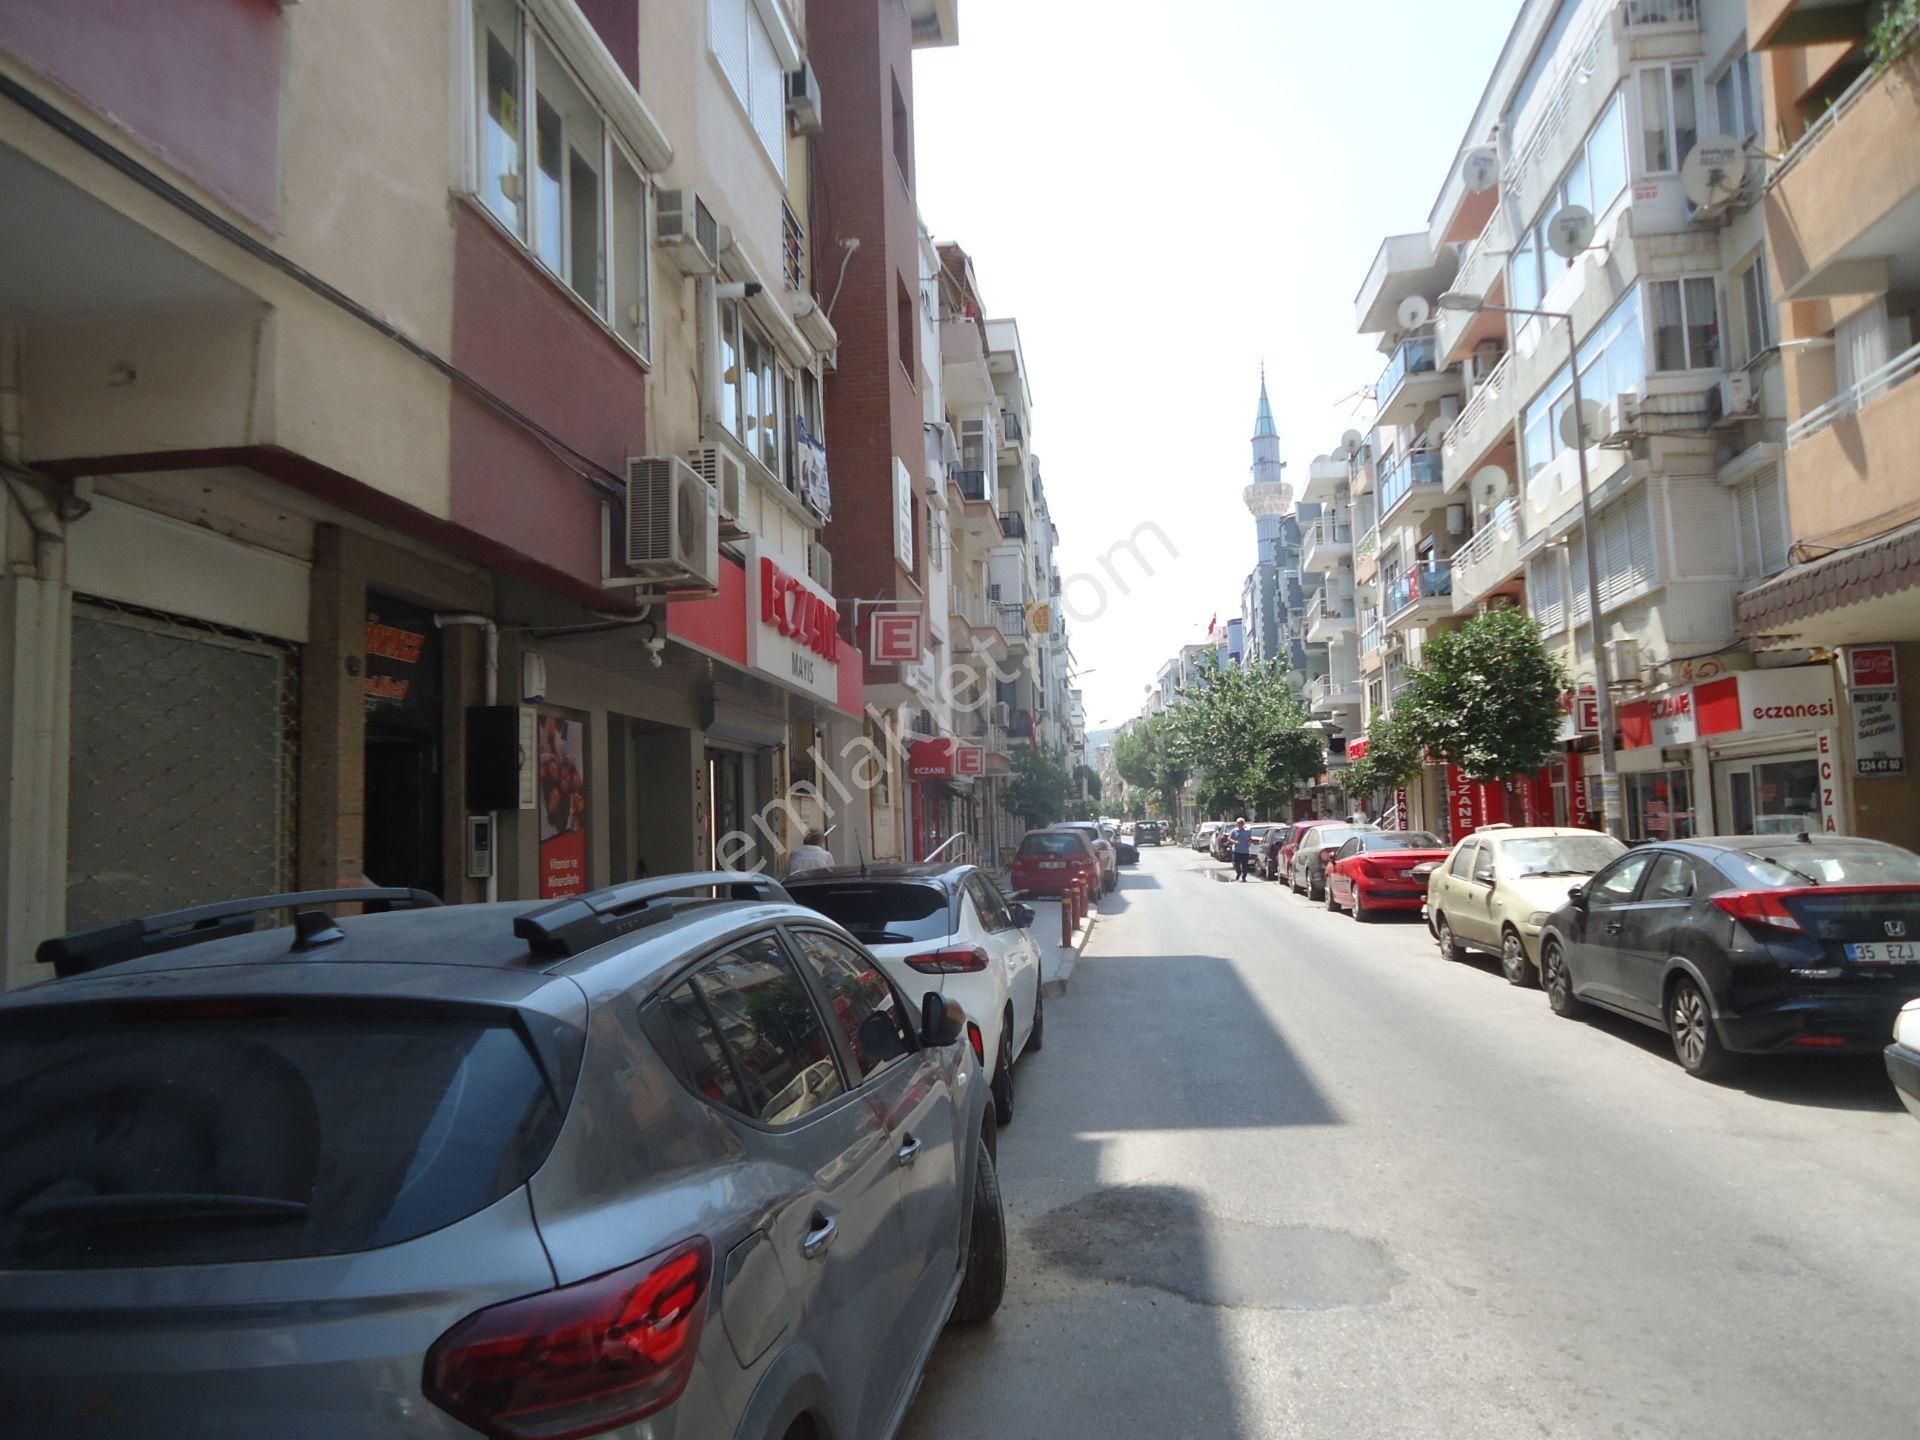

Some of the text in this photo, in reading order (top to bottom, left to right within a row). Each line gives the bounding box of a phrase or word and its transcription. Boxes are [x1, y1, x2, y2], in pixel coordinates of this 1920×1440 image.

[882, 621, 913, 656] E
[791, 651, 814, 685] MAYIS
[1753, 698, 1834, 719] eczanesi
[960, 752, 979, 769] E
[914, 767, 945, 775] ECZANE
[1856, 944, 1914, 960] 35 EZJ
